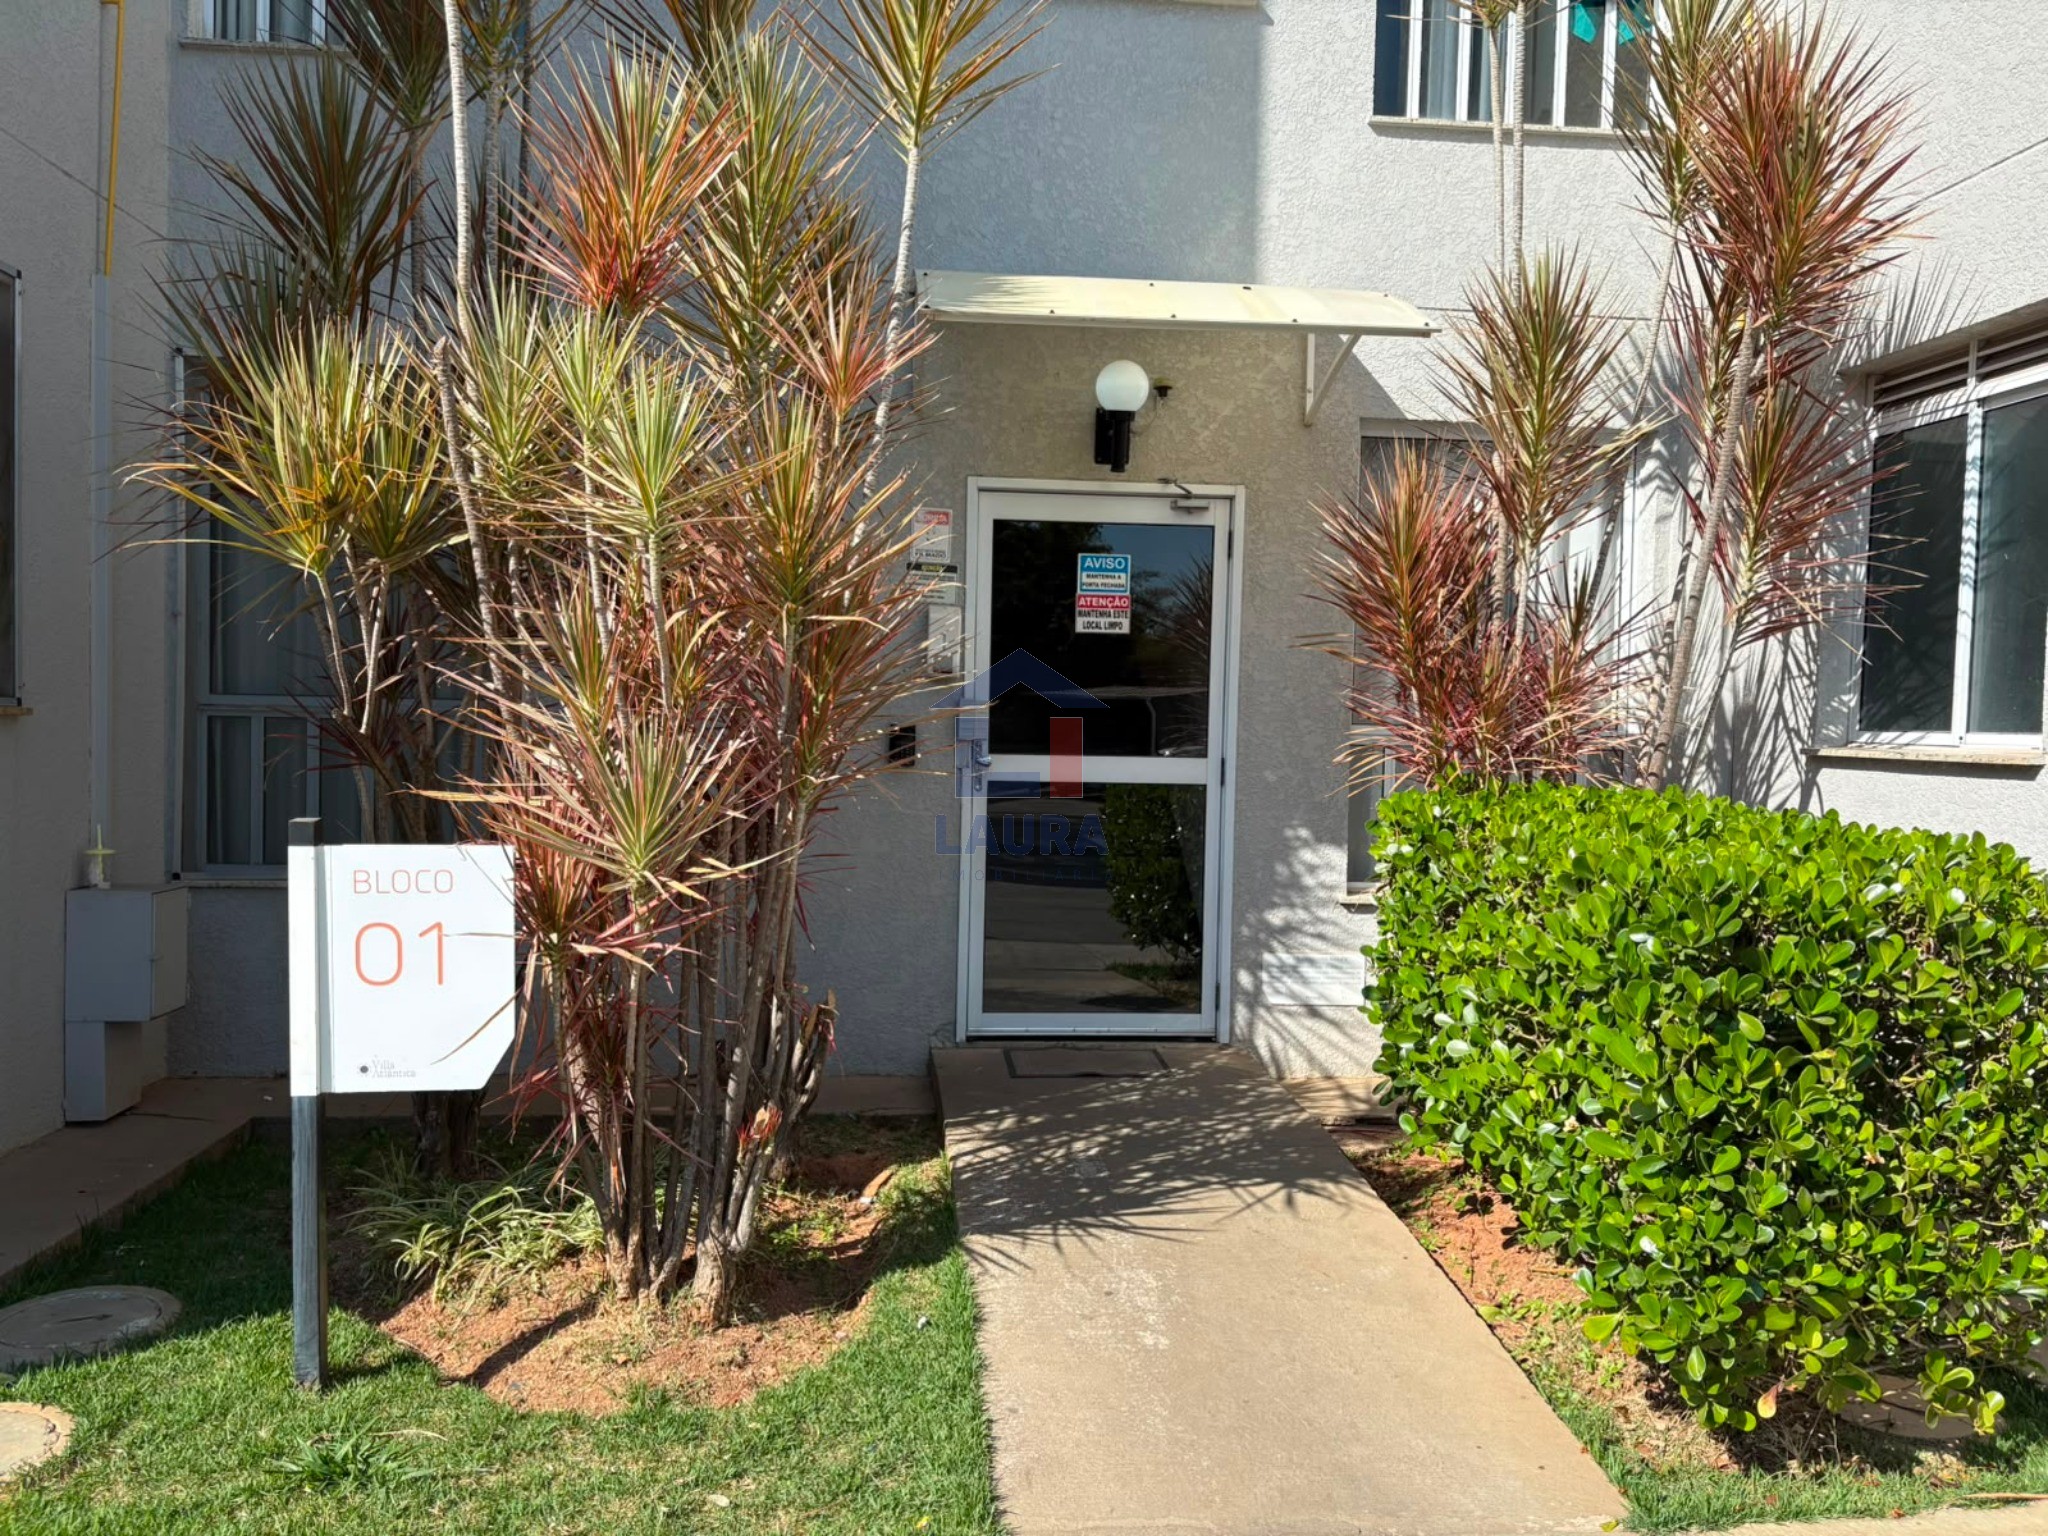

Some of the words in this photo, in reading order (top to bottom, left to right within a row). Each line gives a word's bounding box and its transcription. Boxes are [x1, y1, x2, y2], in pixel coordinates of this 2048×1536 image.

[1084, 558, 1125, 569] AVISO
[1079, 595, 1129, 608] ATENÇÃO
[1078, 610, 1112, 618] MANTENHA
[1113, 610, 1128, 619] ESTE
[1082, 621, 1102, 630] LOCAL
[1104, 621, 1123, 630] LIMPO
[353, 869, 454, 894] BLOCO
[355, 921, 444, 987] 01
[371, 1059, 395, 1069] Villa
